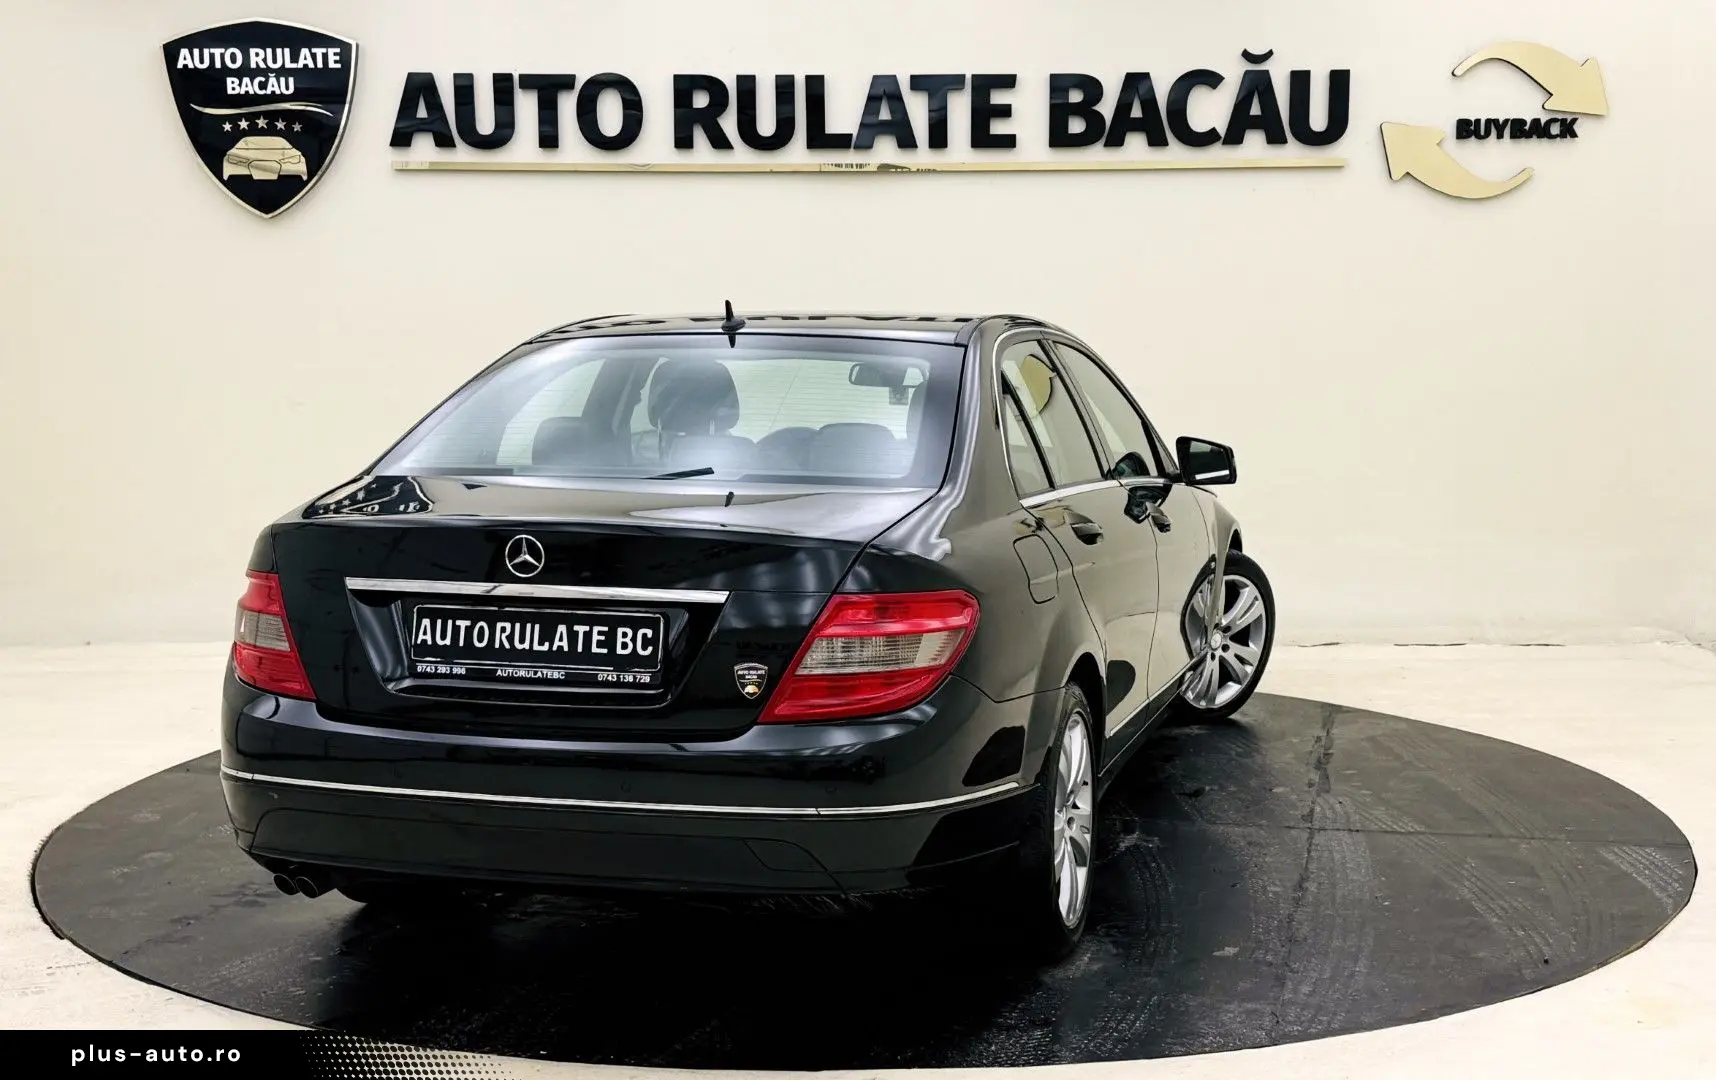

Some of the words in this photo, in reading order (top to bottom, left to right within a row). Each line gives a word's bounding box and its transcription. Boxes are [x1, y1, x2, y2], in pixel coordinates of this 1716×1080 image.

[177, 47, 243, 69] AUTO
[249, 47, 342, 69] RULATE
[226, 73, 295, 95] BACĂU
[390, 72, 643, 151] AUTO
[673, 73, 1018, 150] RULATE
[1049, 48, 1350, 149] BACĂU
[1456, 117, 1579, 140] BUYBACK
[615, 627, 654, 656] BC
[496, 669, 566, 679] AUTORULATEBC
[597, 673, 617, 682] 0743
[636, 675, 650, 683] 729
